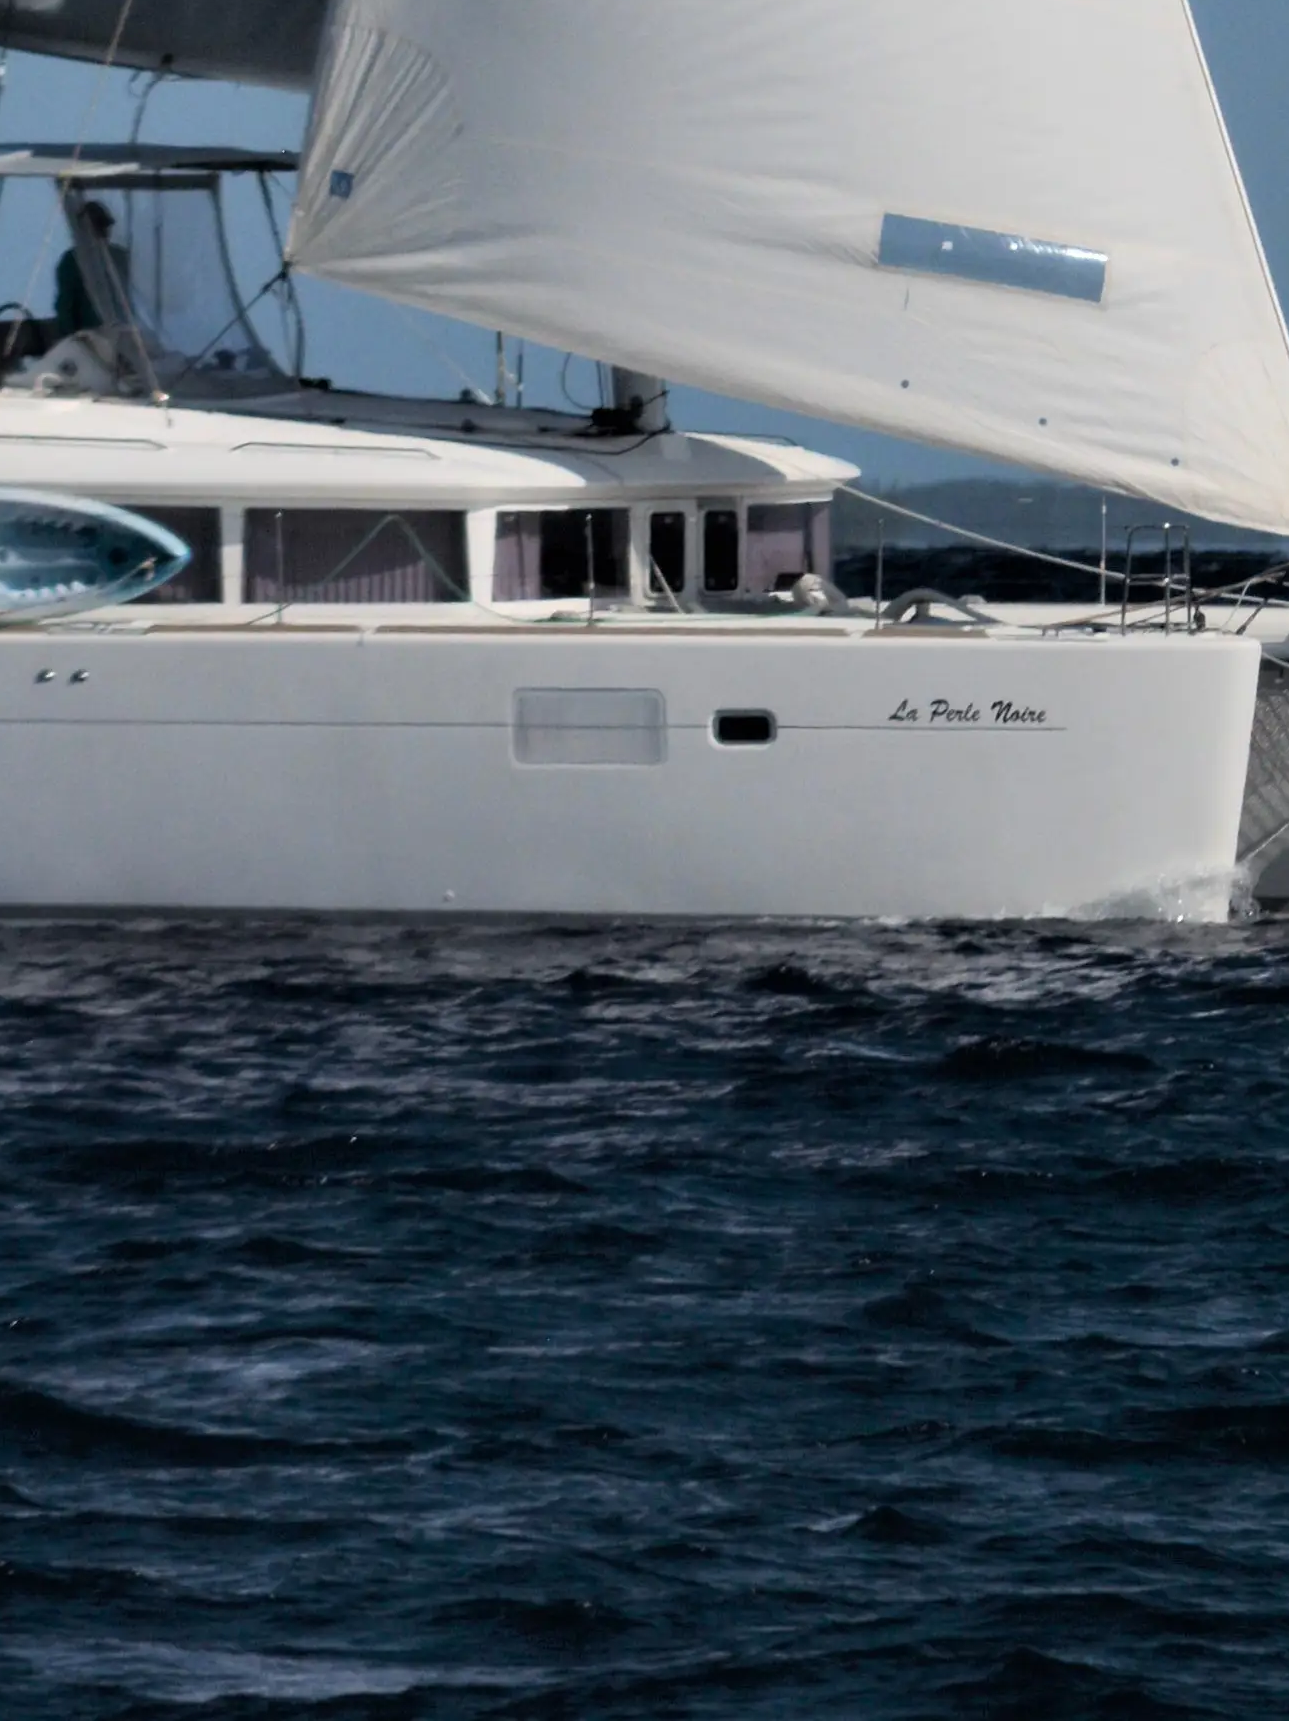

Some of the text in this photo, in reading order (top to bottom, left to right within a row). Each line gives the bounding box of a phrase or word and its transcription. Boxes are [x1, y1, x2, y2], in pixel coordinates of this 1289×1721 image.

[887, 698, 1046, 724] La Perle Noire
